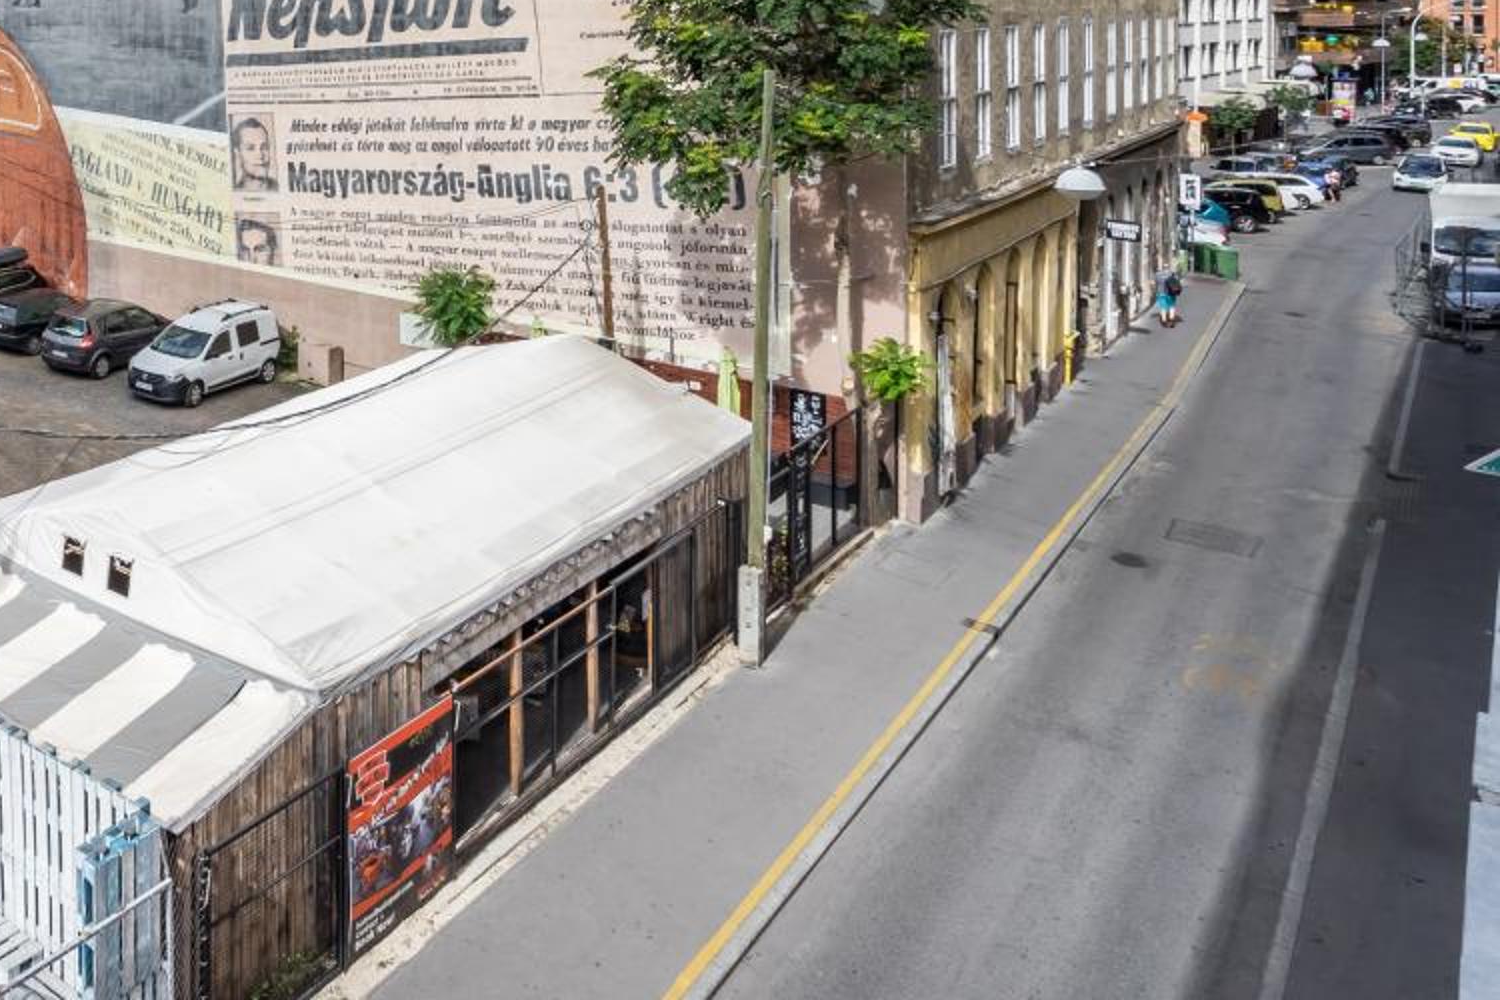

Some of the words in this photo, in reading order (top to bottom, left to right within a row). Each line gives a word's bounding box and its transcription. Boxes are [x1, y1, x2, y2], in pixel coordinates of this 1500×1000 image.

[527, 119, 537, 131] a
[540, 119, 592, 133] magyar
[388, 141, 413, 155] meg
[431, 138, 463, 155] angol
[583, 164, 639, 203] 6:3
[151, 181, 224, 234] HUNGARY
[705, 222, 748, 240] olyan
